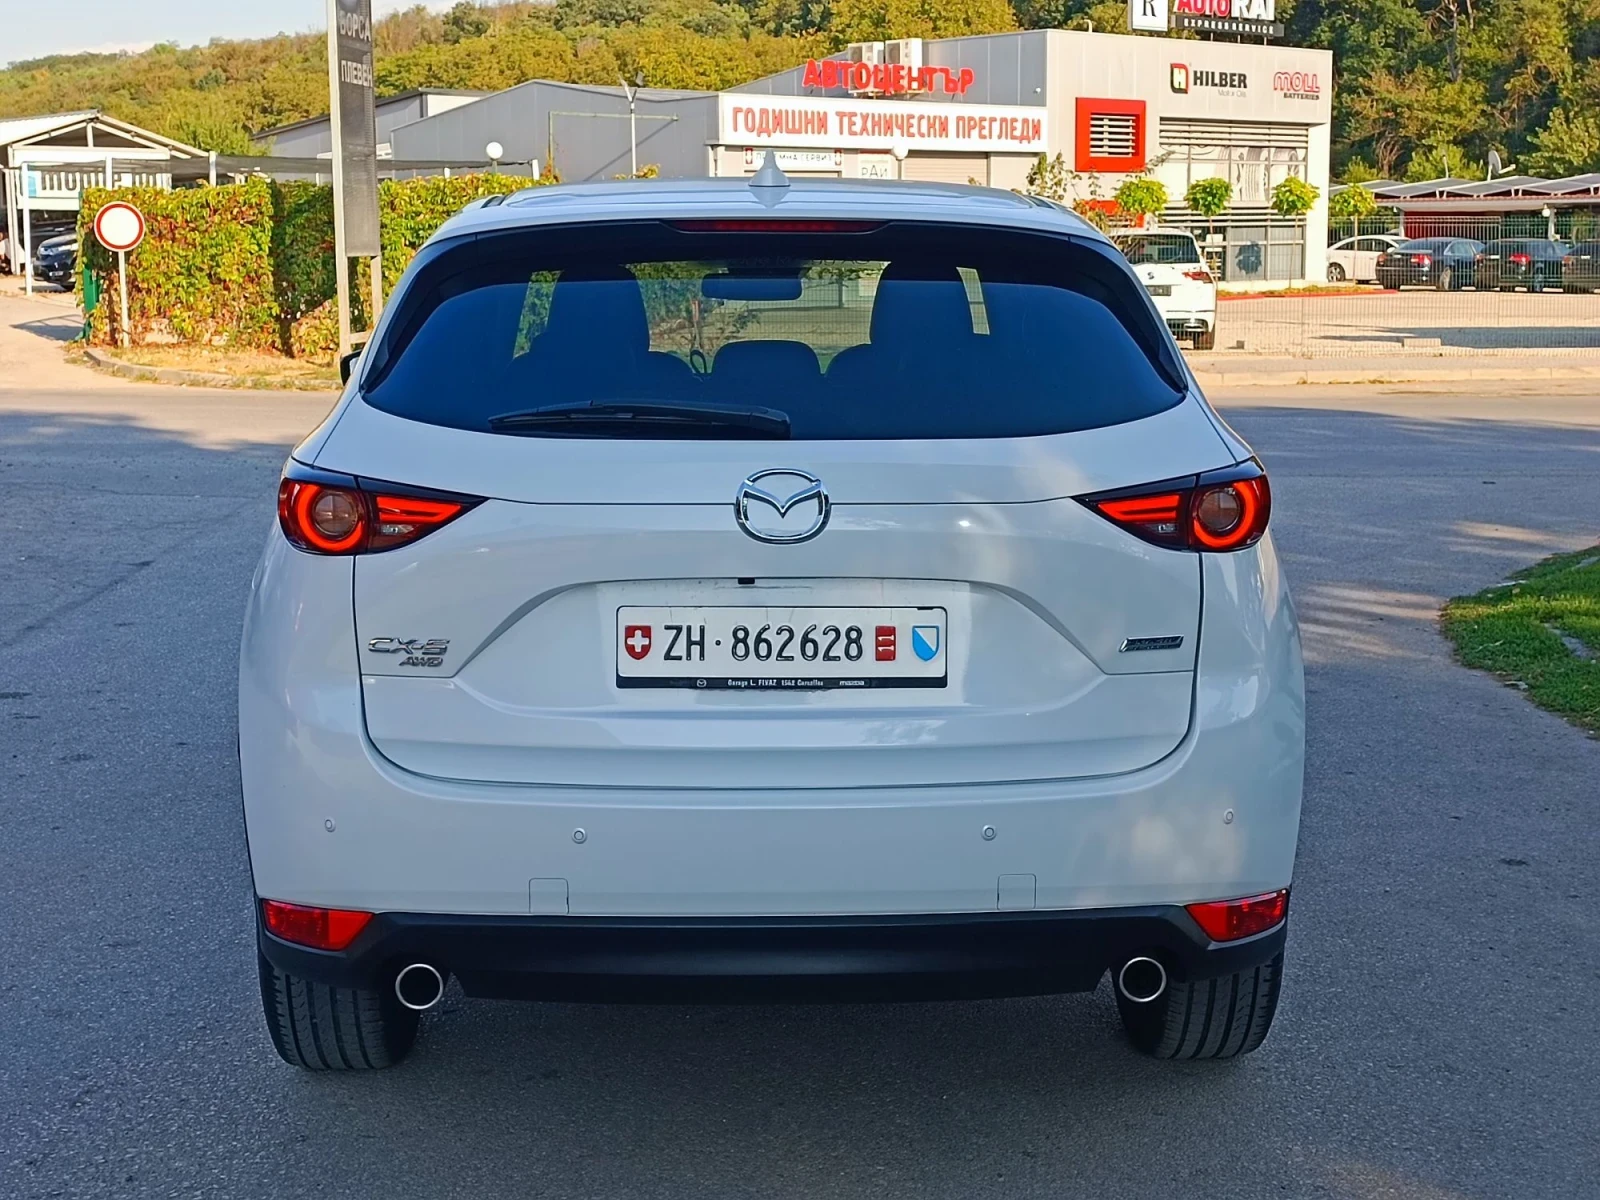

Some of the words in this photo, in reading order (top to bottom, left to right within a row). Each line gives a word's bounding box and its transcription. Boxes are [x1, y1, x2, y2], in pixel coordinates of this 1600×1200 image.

[1183, 18, 1229, 30] EXPRESS
[1231, 22, 1274, 34] SERVICE
[341, 60, 372, 88] ПЛЕВЕН
[803, 58, 975, 95] АВТОЦЕНТЪР
[1193, 70, 1248, 89] HILBER
[1283, 92, 1320, 101] BATTERIES
[732, 106, 828, 138] ГОДИШНИ
[835, 111, 949, 139] ТЕХНИЧЕСКИ
[955, 115, 1042, 145] ПРЕГЛЕДИ
[368, 637, 450, 655] CX-5
[398, 656, 443, 668] AWD
[727, 679, 748, 687] Garage
